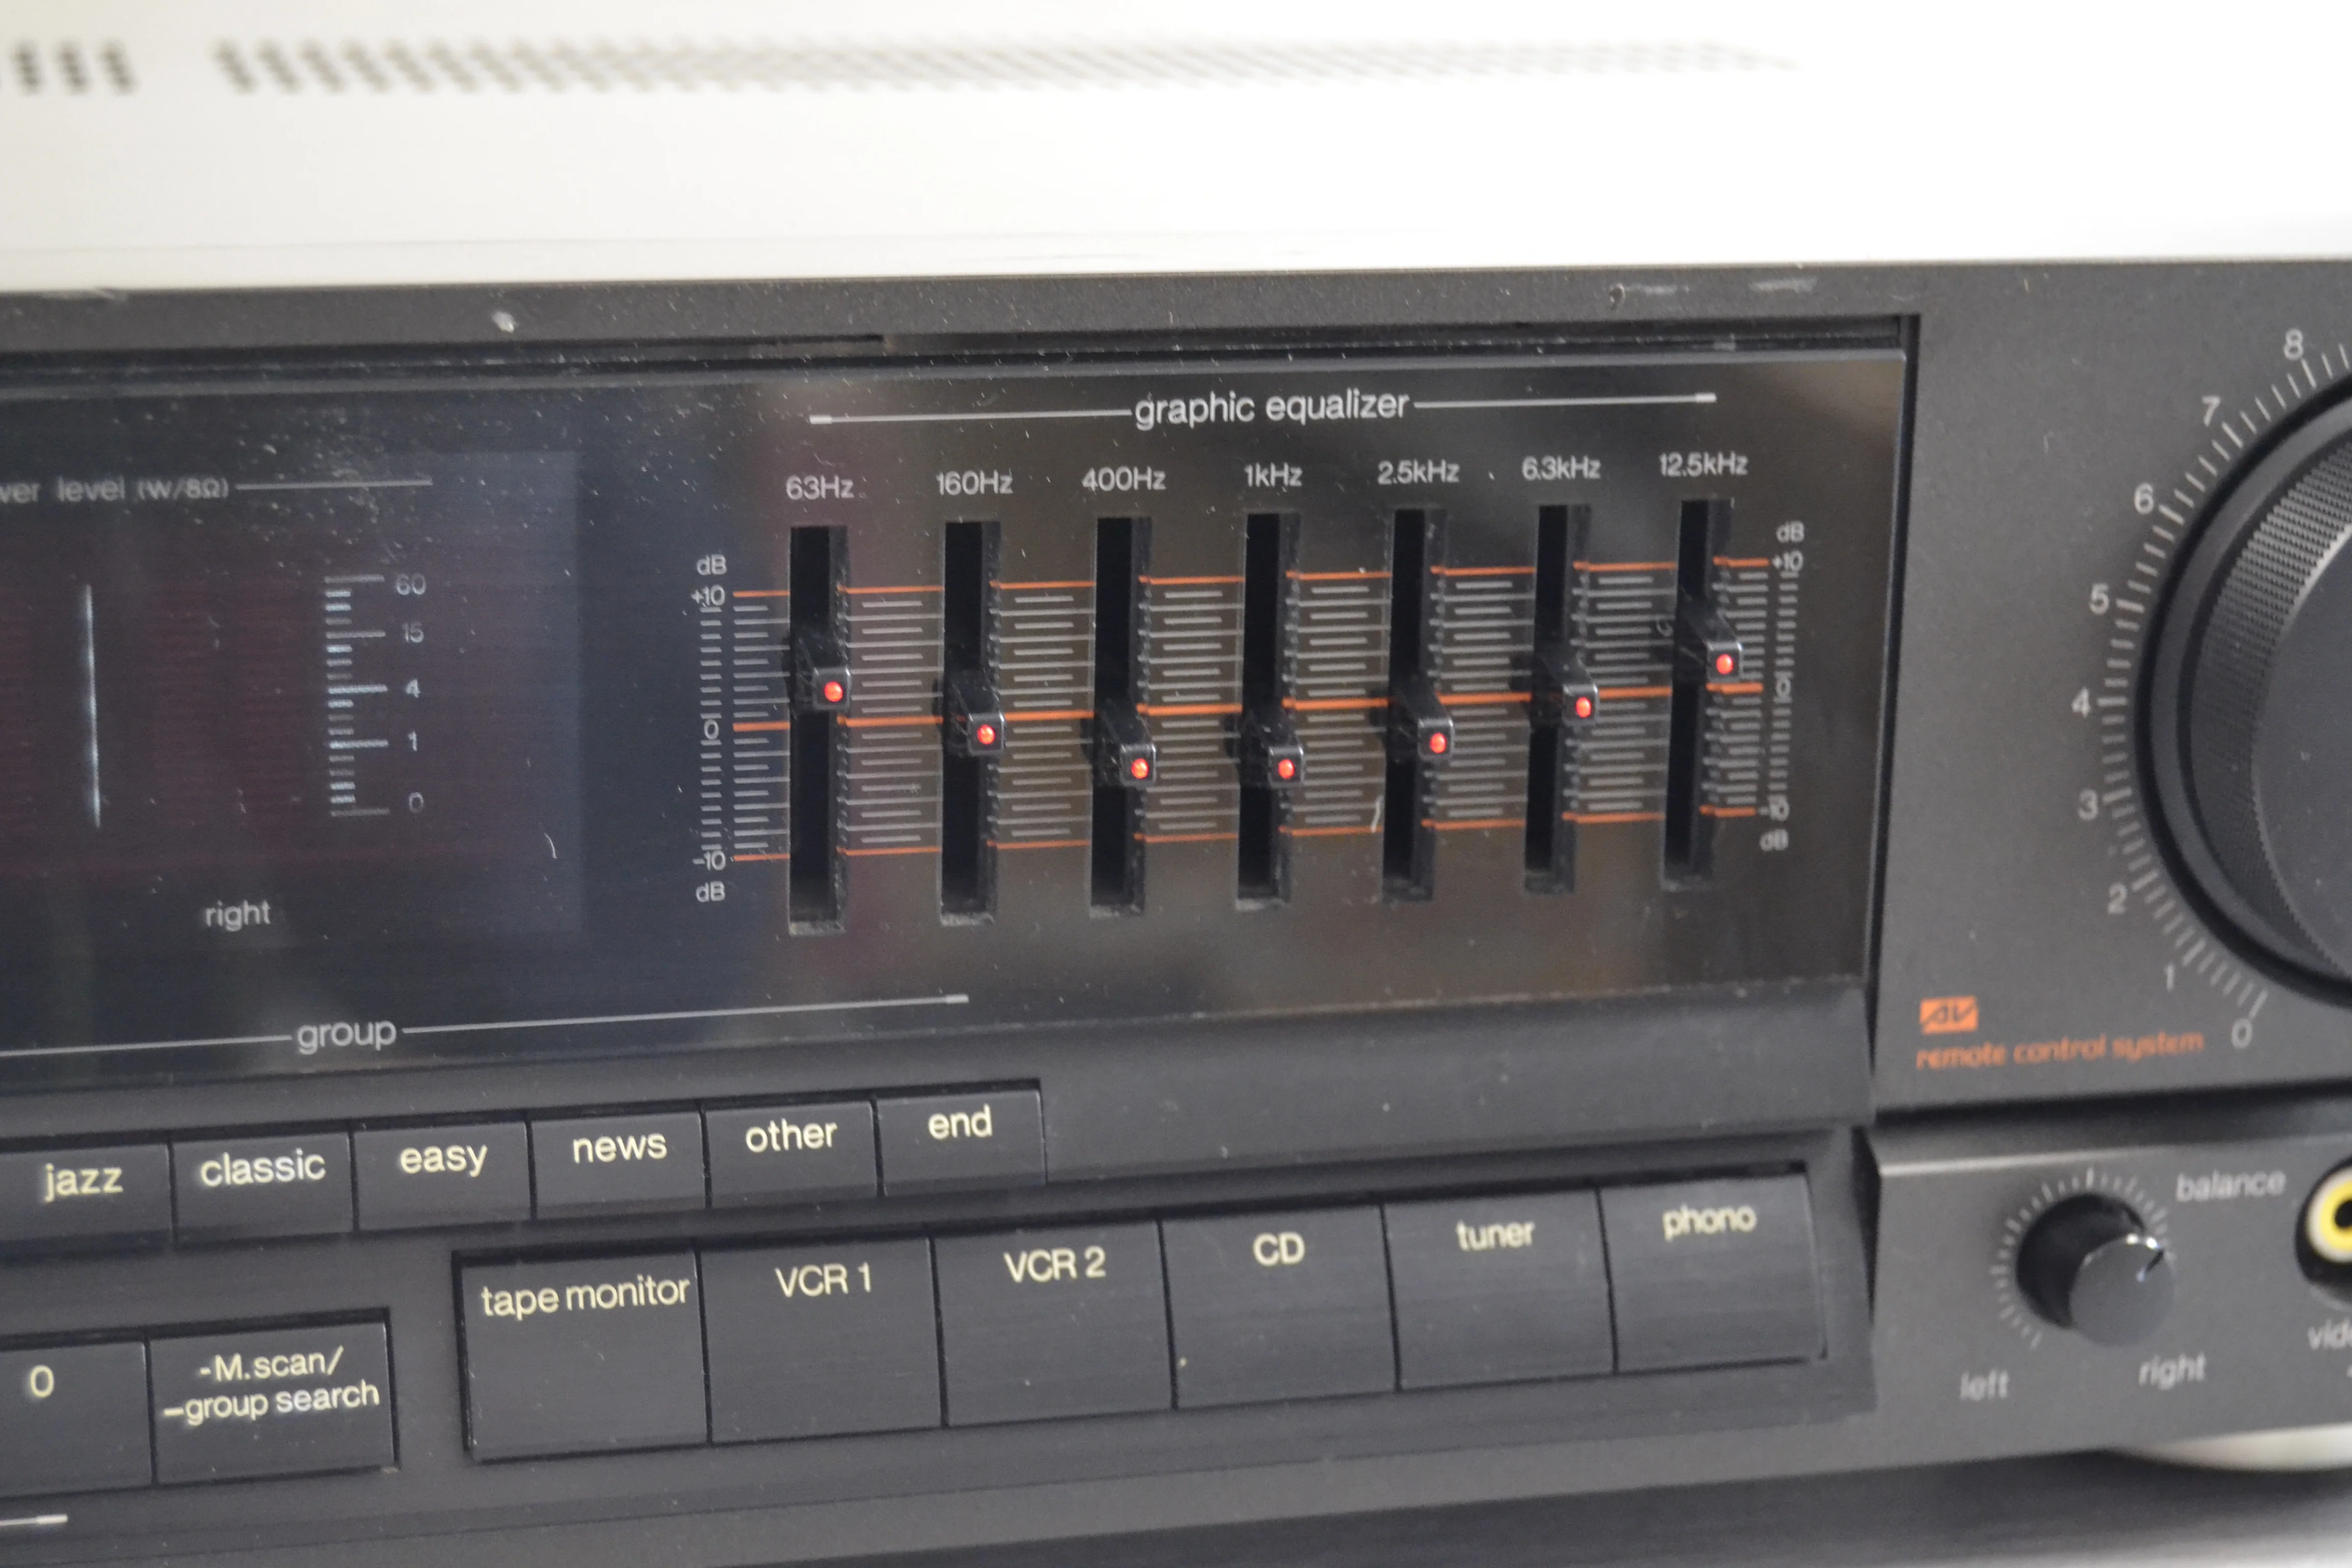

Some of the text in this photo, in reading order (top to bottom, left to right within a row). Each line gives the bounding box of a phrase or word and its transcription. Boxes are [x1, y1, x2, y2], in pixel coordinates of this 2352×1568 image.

[2284, 328, 2304, 360] 8
[1135, 389, 1410, 431] graphic equalizer
[2201, 395, 2220, 426] 7
[1082, 466, 1167, 492] 400Hz
[1244, 463, 1303, 488] 1kHz
[1377, 459, 1460, 485] 2.5kHz
[1521, 455, 1602, 481] 6.3kHz
[1659, 451, 1749, 477] 12.5kHz
[57, 474, 125, 503] level
[786, 474, 854, 500] 63Hz
[936, 470, 1014, 496] 160Hz
[2134, 483, 2154, 514] 6
[1776, 520, 1805, 543] dB
[696, 553, 727, 576] dB
[1771, 550, 1804, 572] +10
[395, 573, 427, 595] 60
[691, 584, 725, 606] +10
[2089, 583, 2110, 614] 5
[401, 621, 425, 644] 15
[405, 678, 420, 698] 4
[2071, 687, 2091, 717] 4
[408, 731, 418, 751] 1
[704, 719, 720, 741] 0
[409, 791, 425, 813] 0
[2077, 788, 2099, 820] 3
[1759, 828, 1790, 852] dB
[692, 849, 726, 871] -10
[696, 880, 725, 902] dB
[2108, 882, 2128, 915] 2
[204, 899, 272, 932] right
[2163, 963, 2175, 991] 1
[296, 1019, 397, 1055] group
[2231, 1019, 2252, 1048] 0
[1916, 1031, 2204, 1071] remote control system
[744, 1118, 838, 1154] other
[927, 1104, 993, 1140] end
[400, 1144, 488, 1178] easy
[572, 1132, 668, 1164] news
[42, 1163, 124, 1203] jazz
[199, 1147, 327, 1188] classic
[2175, 1169, 2287, 1202] balance
[1456, 1218, 1535, 1253] tuner
[1661, 1202, 1758, 1241] phono
[1002, 1246, 1108, 1283] VCR 2
[1252, 1231, 1307, 1267] CD
[775, 1262, 872, 1298] VCR 1
[480, 1273, 691, 1321] tape monitor
[2307, 1316, 2352, 1350] vid
[29, 1365, 55, 1398] 0
[1959, 1370, 2010, 1401] left
[2139, 1354, 2207, 1389] right
[276, 1379, 380, 1414] search
